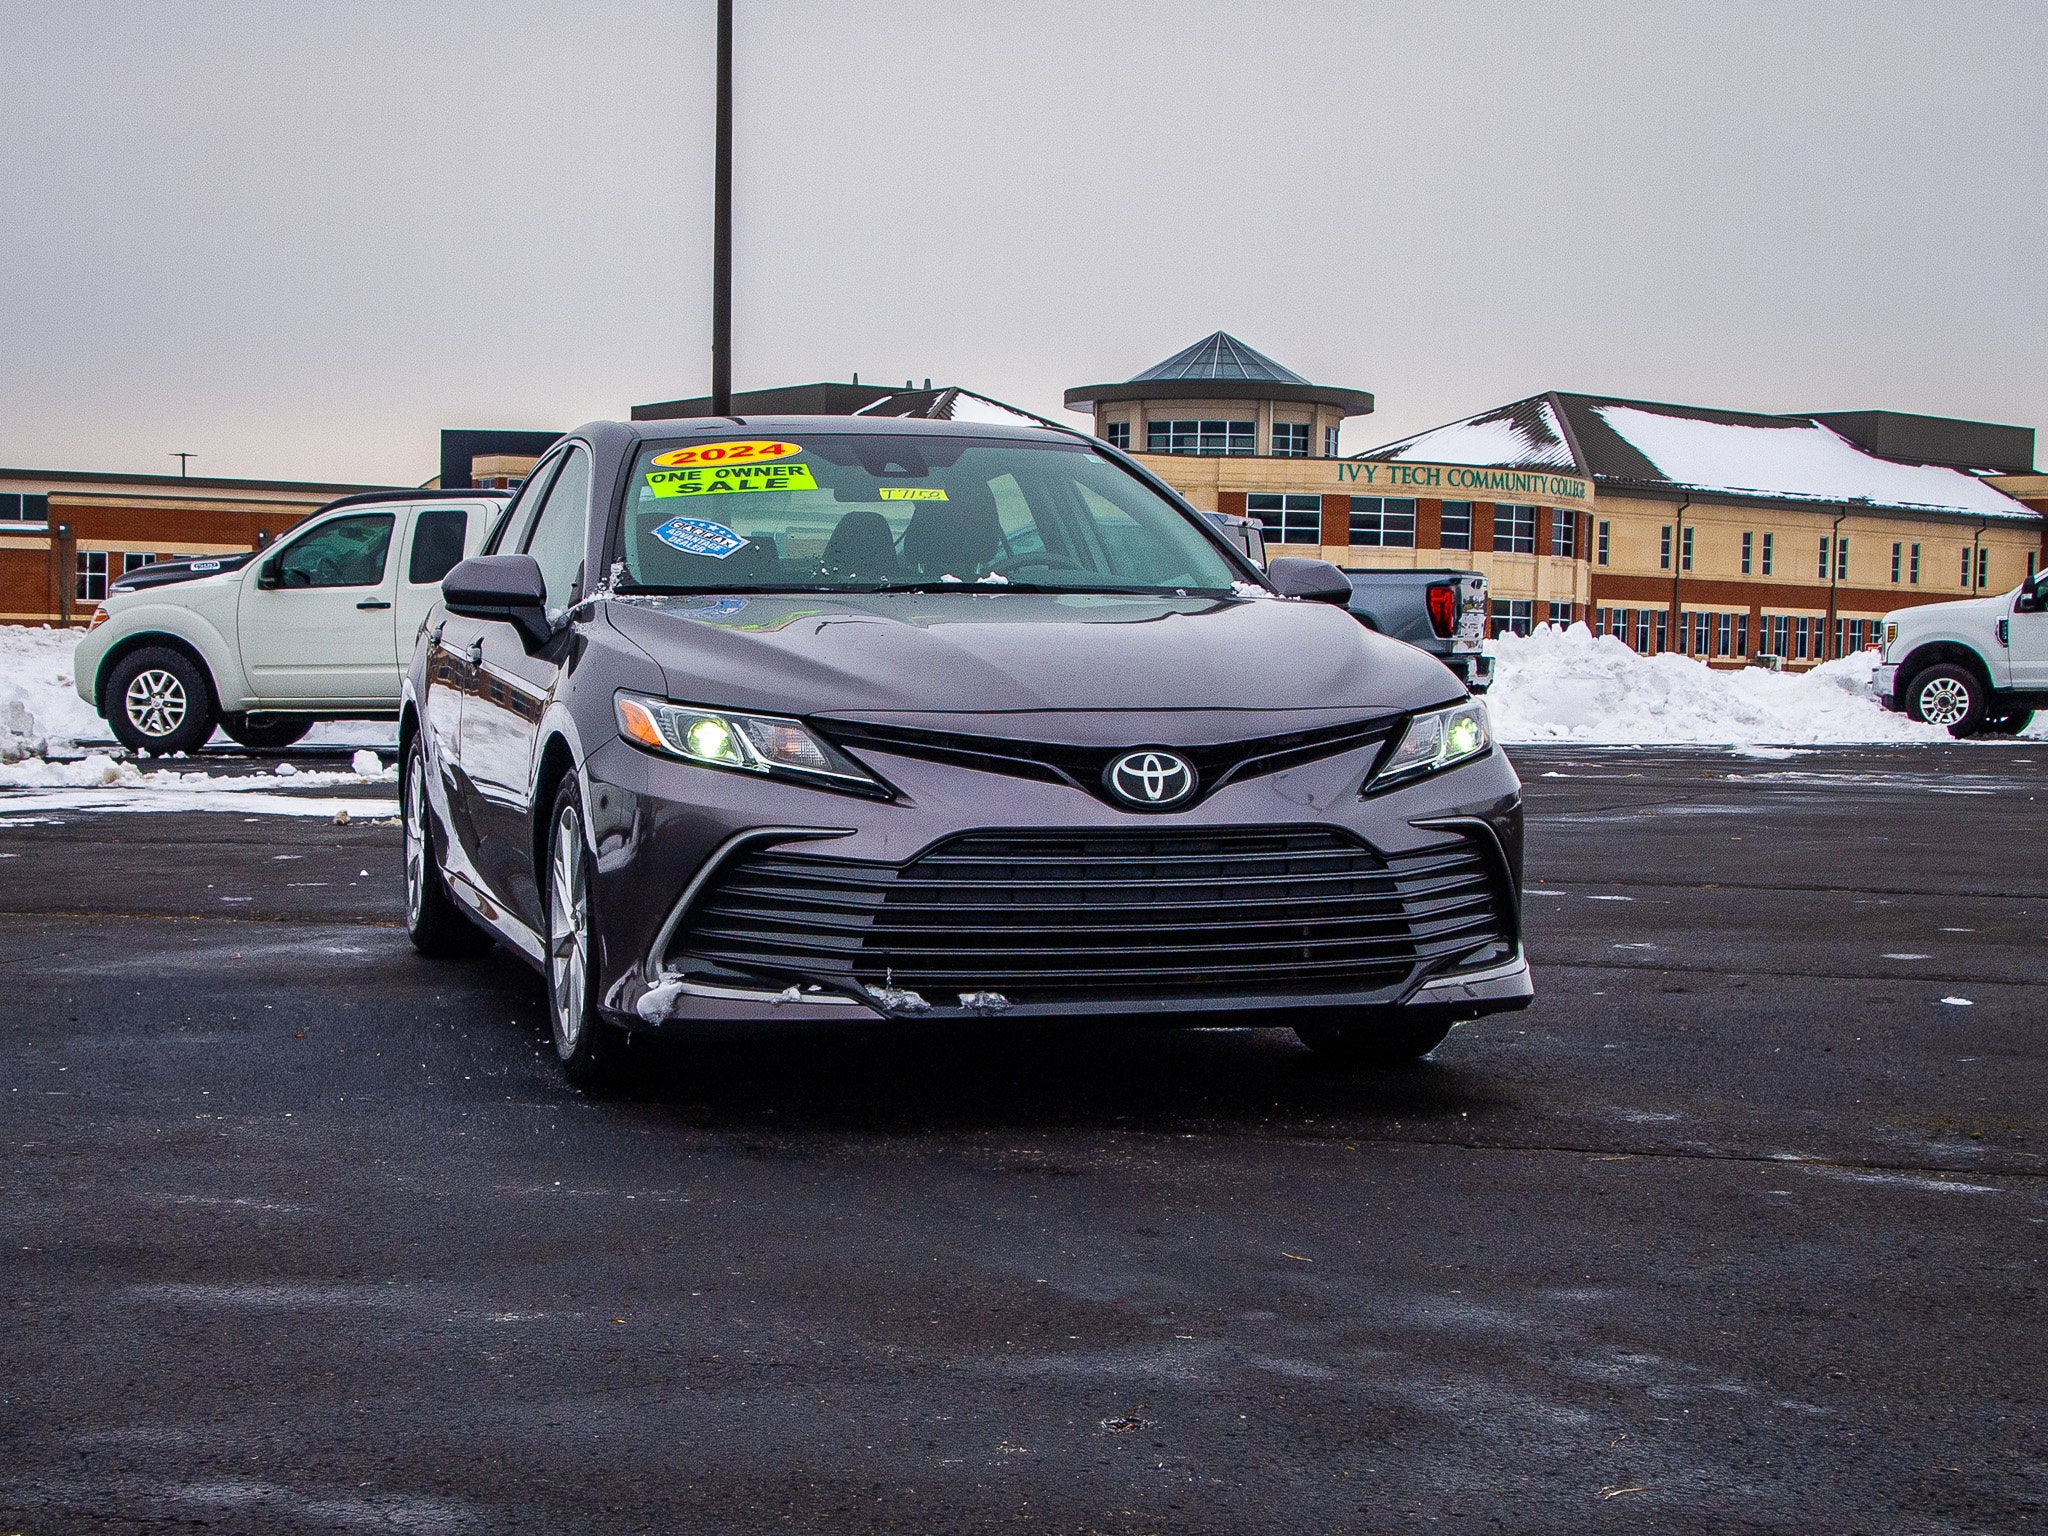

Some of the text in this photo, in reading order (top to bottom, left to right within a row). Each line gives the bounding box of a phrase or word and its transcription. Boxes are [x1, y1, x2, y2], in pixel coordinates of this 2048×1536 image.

[671, 443, 786, 466] 2024
[651, 466, 805, 484] ONE OWNER
[675, 477, 790, 494] SALE
[1338, 463, 1379, 483] IVY
[1386, 465, 1442, 486] TECH
[1447, 468, 1548, 494] COMMUNITY
[666, 529, 723, 551] ADVANTAGE
[668, 536, 706, 553] DEALER
[669, 521, 739, 548] CARFAX
